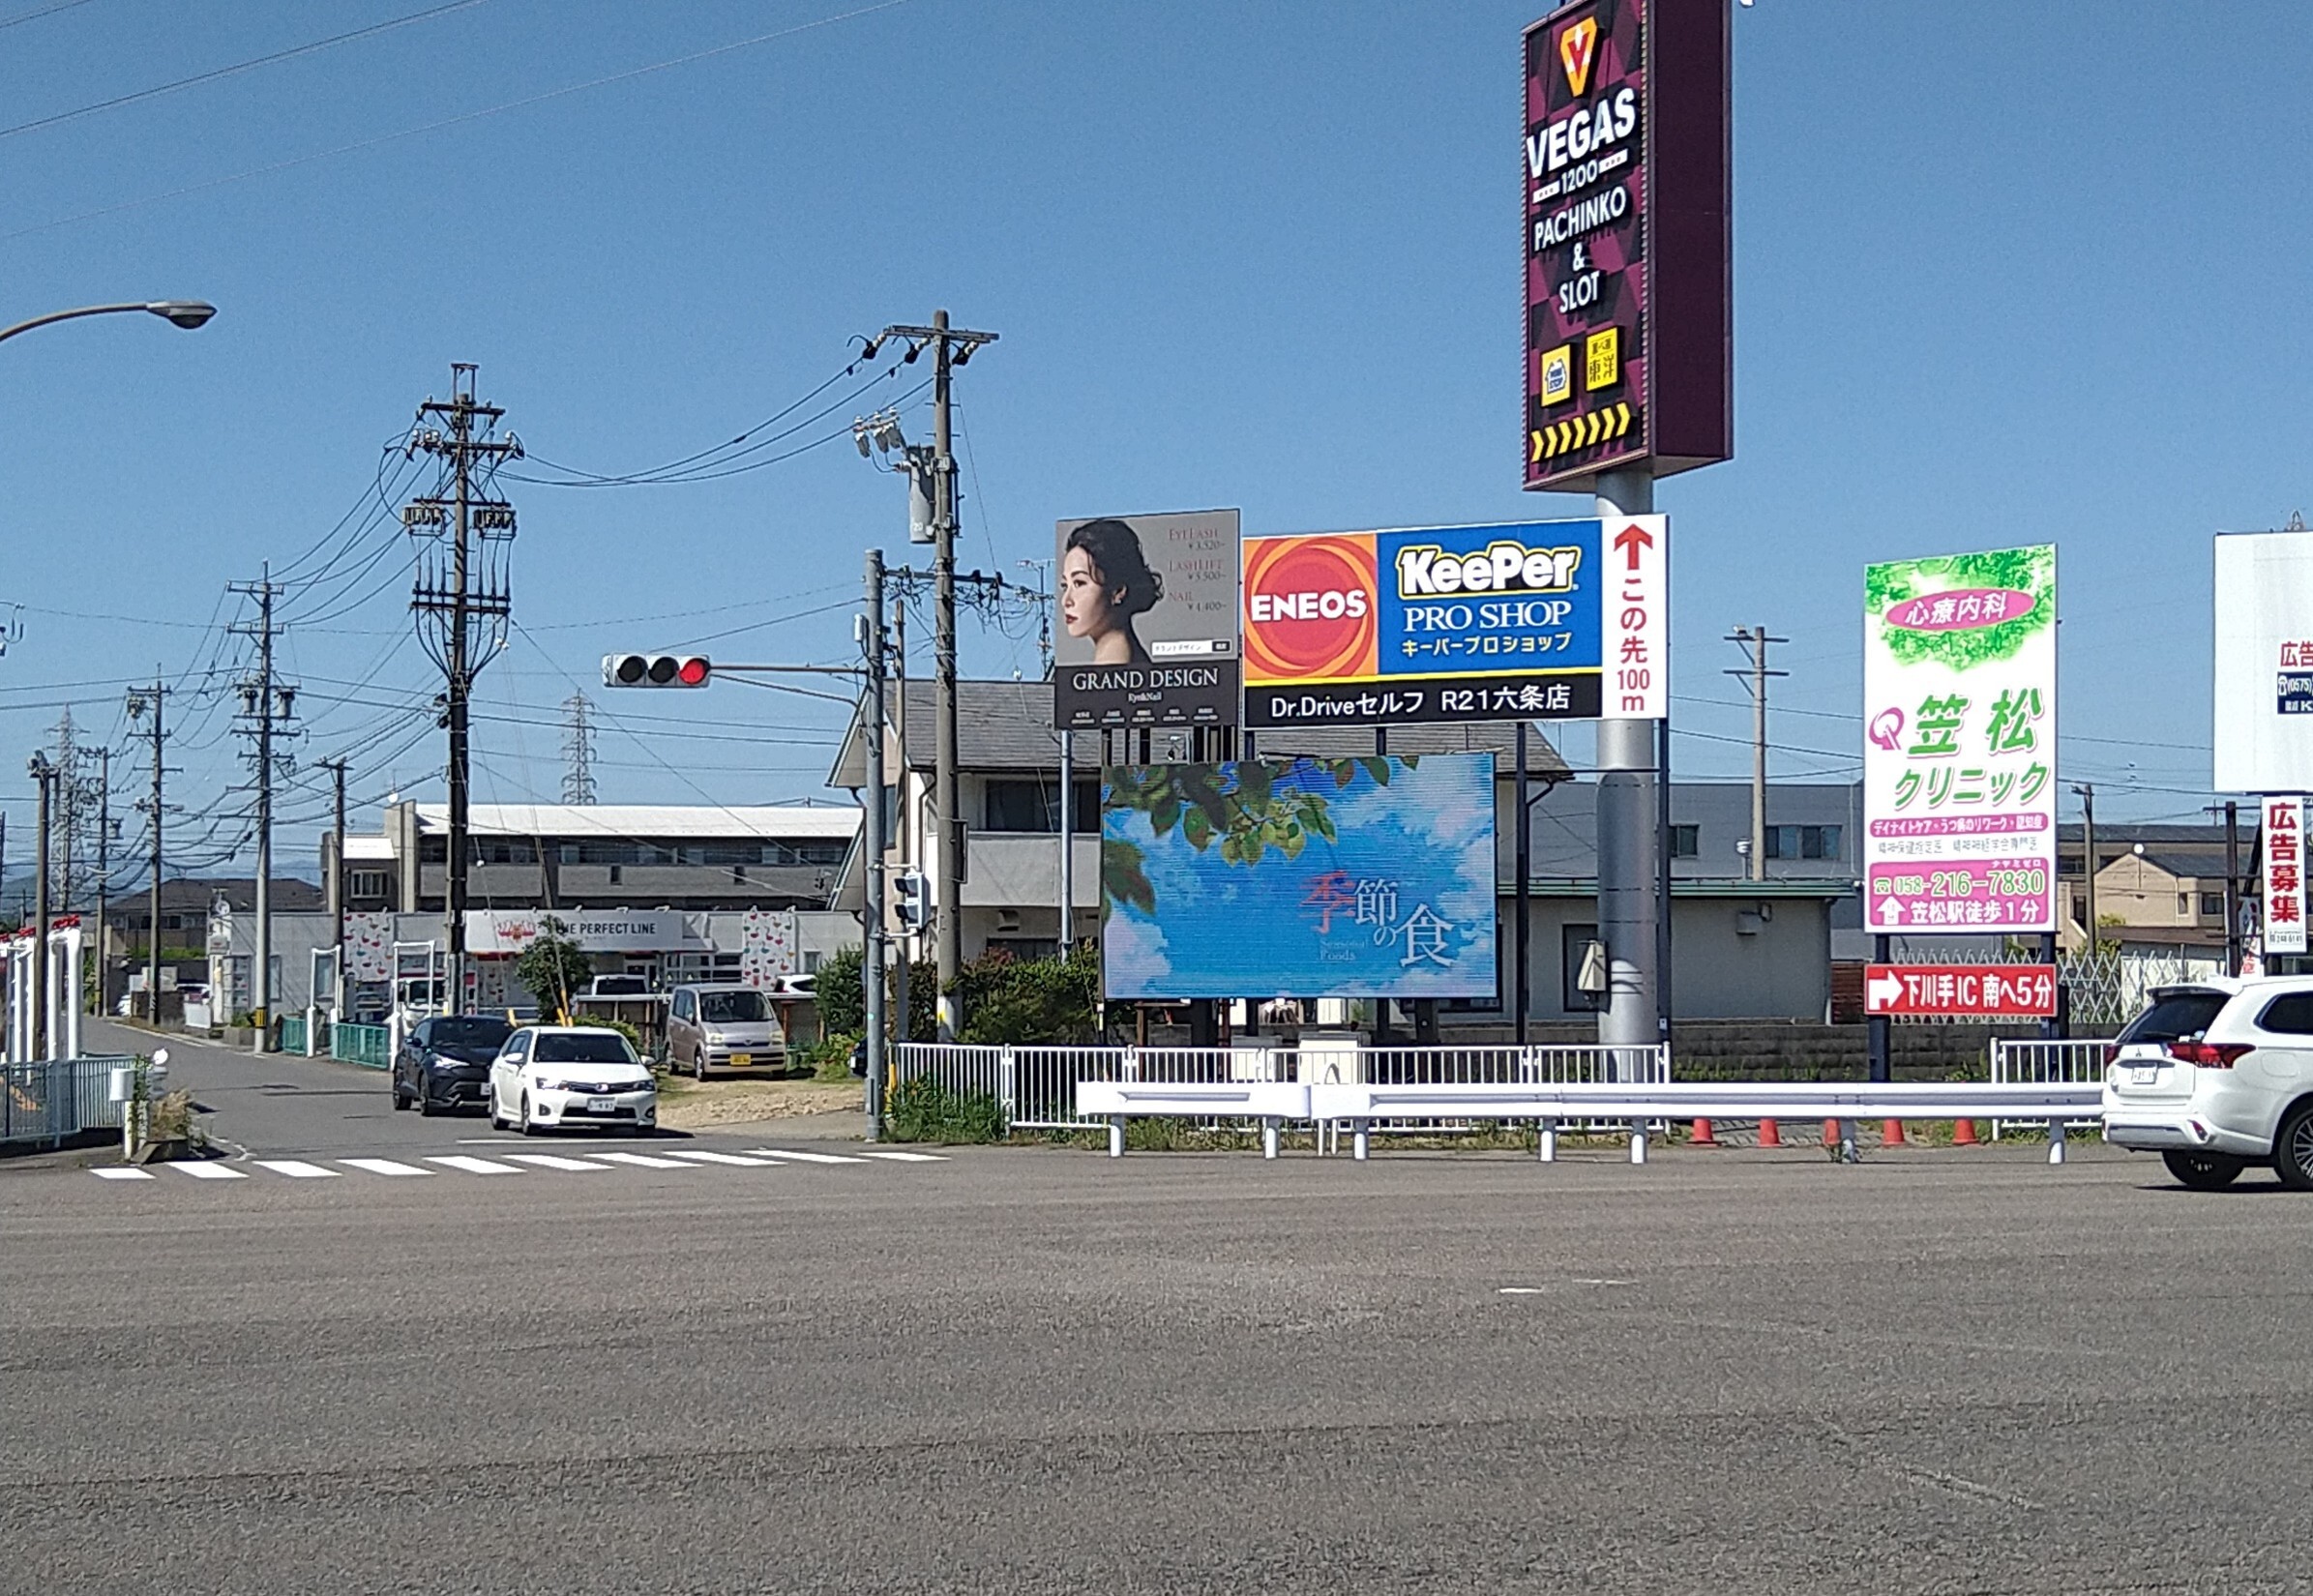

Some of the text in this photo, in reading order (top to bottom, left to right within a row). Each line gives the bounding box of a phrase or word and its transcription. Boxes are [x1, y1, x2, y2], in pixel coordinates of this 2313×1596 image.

[1527, 88, 1636, 179] VEGAS
[1561, 159, 1598, 194] 1200
[1534, 186, 1627, 251] PACHINKO
[1572, 242, 1585, 272] &
[1558, 271, 1600, 313] SLOT
[1401, 546, 1578, 595] KeePer
[1251, 590, 1367, 622] ENEOS
[1404, 601, 1572, 633] PRO SHOP
[1904, 591, 2008, 626] 心療内科
[1402, 632, 1572, 658] キーパープロショップ
[1073, 667, 1219, 691] GRAND DESIGN
[1271, 683, 1572, 718] Dr.Driveセルフ R21六条店
[1908, 687, 2043, 759] 笠松
[1895, 761, 2048, 809] クリニック
[2269, 802, 2299, 923] 広告募集
[580, 923, 628, 934] PERFECT
[631, 923, 656, 934] LINE
[1910, 900, 2040, 924] 笠松駅徒歩1分
